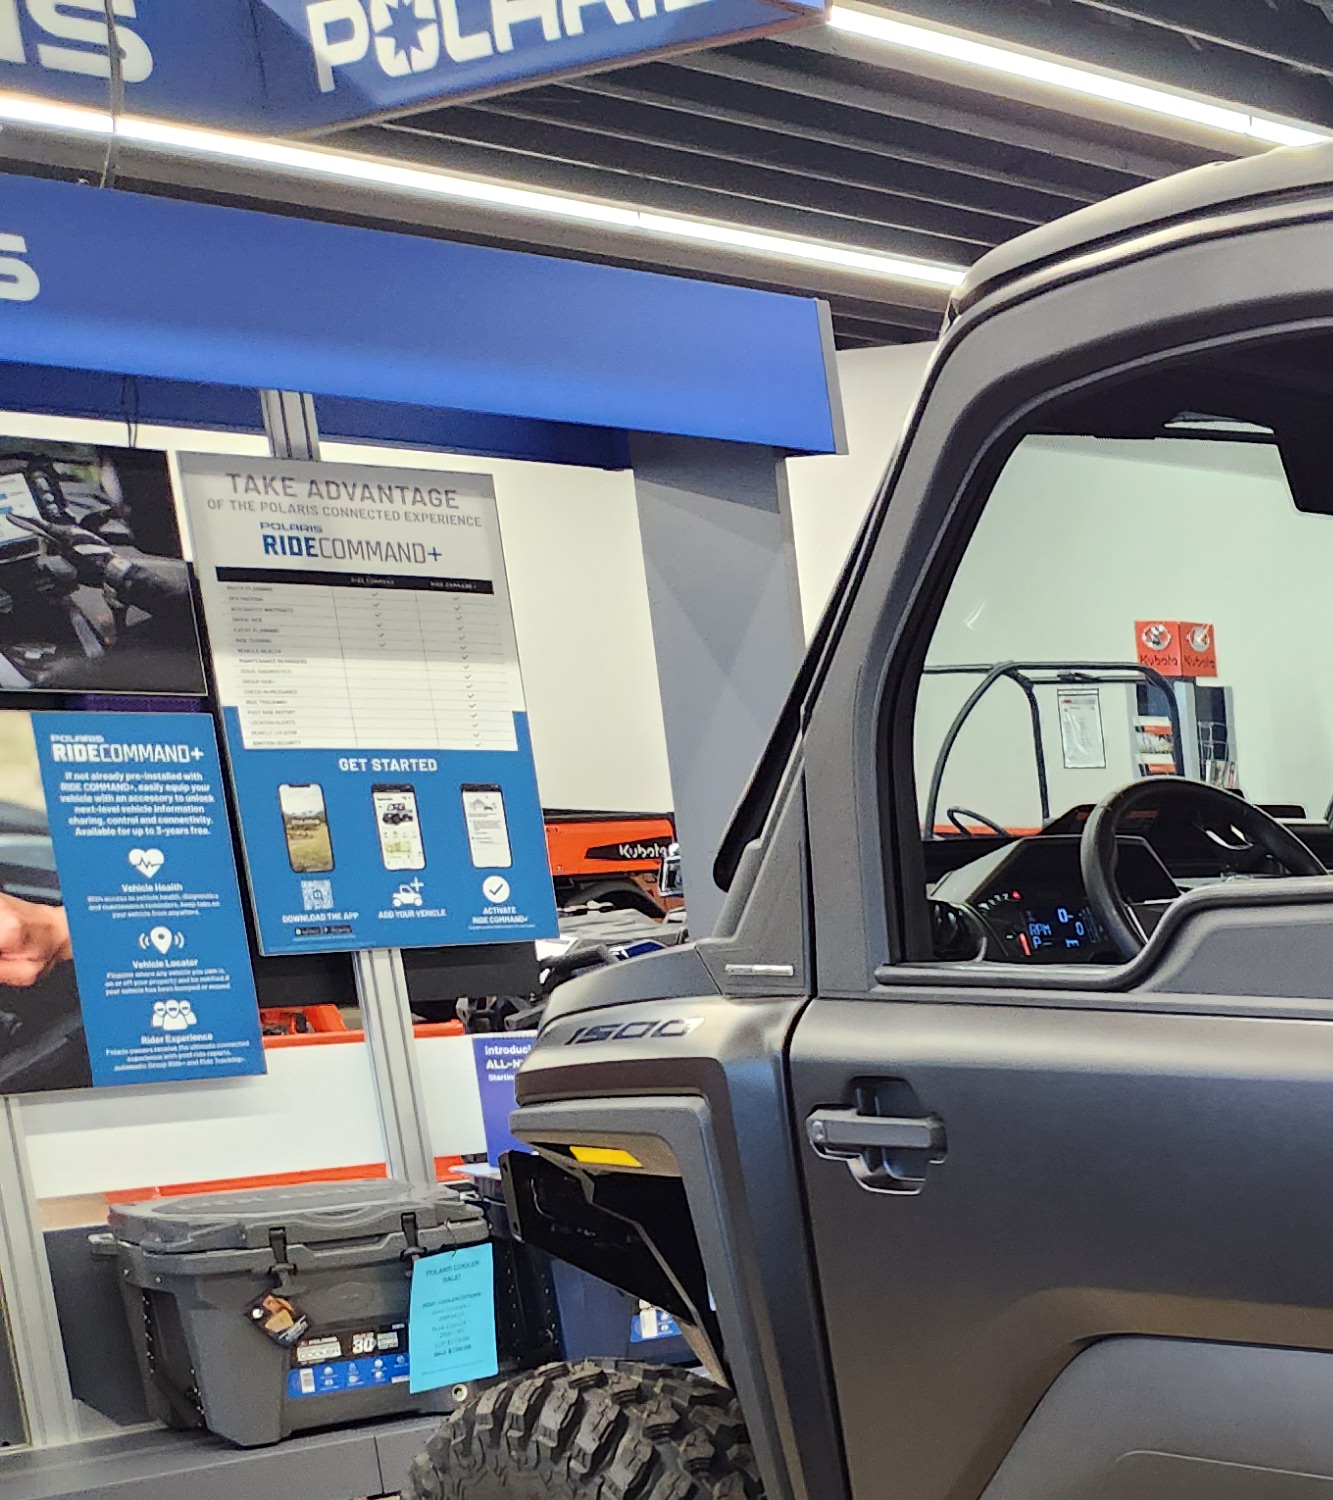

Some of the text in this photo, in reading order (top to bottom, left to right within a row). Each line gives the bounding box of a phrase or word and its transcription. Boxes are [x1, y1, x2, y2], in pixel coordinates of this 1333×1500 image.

[308, 0, 716, 93] POLAR
[226, 473, 459, 509] TAKE ADVANTAGE
[208, 499, 482, 527] OF THE POLARIS CONNECTED EXPERIENCE
[260, 522, 323, 533] POLARIS
[1140, 655, 1178, 666] Kubota
[339, 758, 438, 772] GET STARTED
[74, 772, 89, 780] not
[91, 772, 124, 782] already
[126, 771, 181, 781] pre-installed
[182, 772, 203, 780] with
[60, 782, 82, 791] RIDE
[138, 783, 164, 792] easily
[166, 784, 189, 792] equip
[191, 784, 210, 792] your
[60, 795, 92, 803] vehicle
[94, 794, 114, 803] with
[128, 795, 173, 804] accessory
[185, 795, 215, 803] unlock
[74, 805, 204, 814] next-level vehicle information
[107, 816, 138, 824] control
[140, 816, 156, 824] and
[75, 827, 115, 836] Available
[117, 827, 130, 835] for
[132, 829, 144, 837] up
[618, 842, 668, 859] Kubota
[122, 883, 183, 893] Vehicle Health
[378, 909, 446, 919] ADD YOUR VEHICLE
[483, 906, 516, 915] ACTIVATE
[282, 911, 359, 924] DOWNLOAD THE APP
[472, 916, 488, 924] RIDE
[1028, 923, 1052, 936] RPM
[132, 959, 198, 968] Vehicle Locator
[141, 1033, 213, 1044] Rider Experience
[486, 1058, 523, 1070] ALL-N
